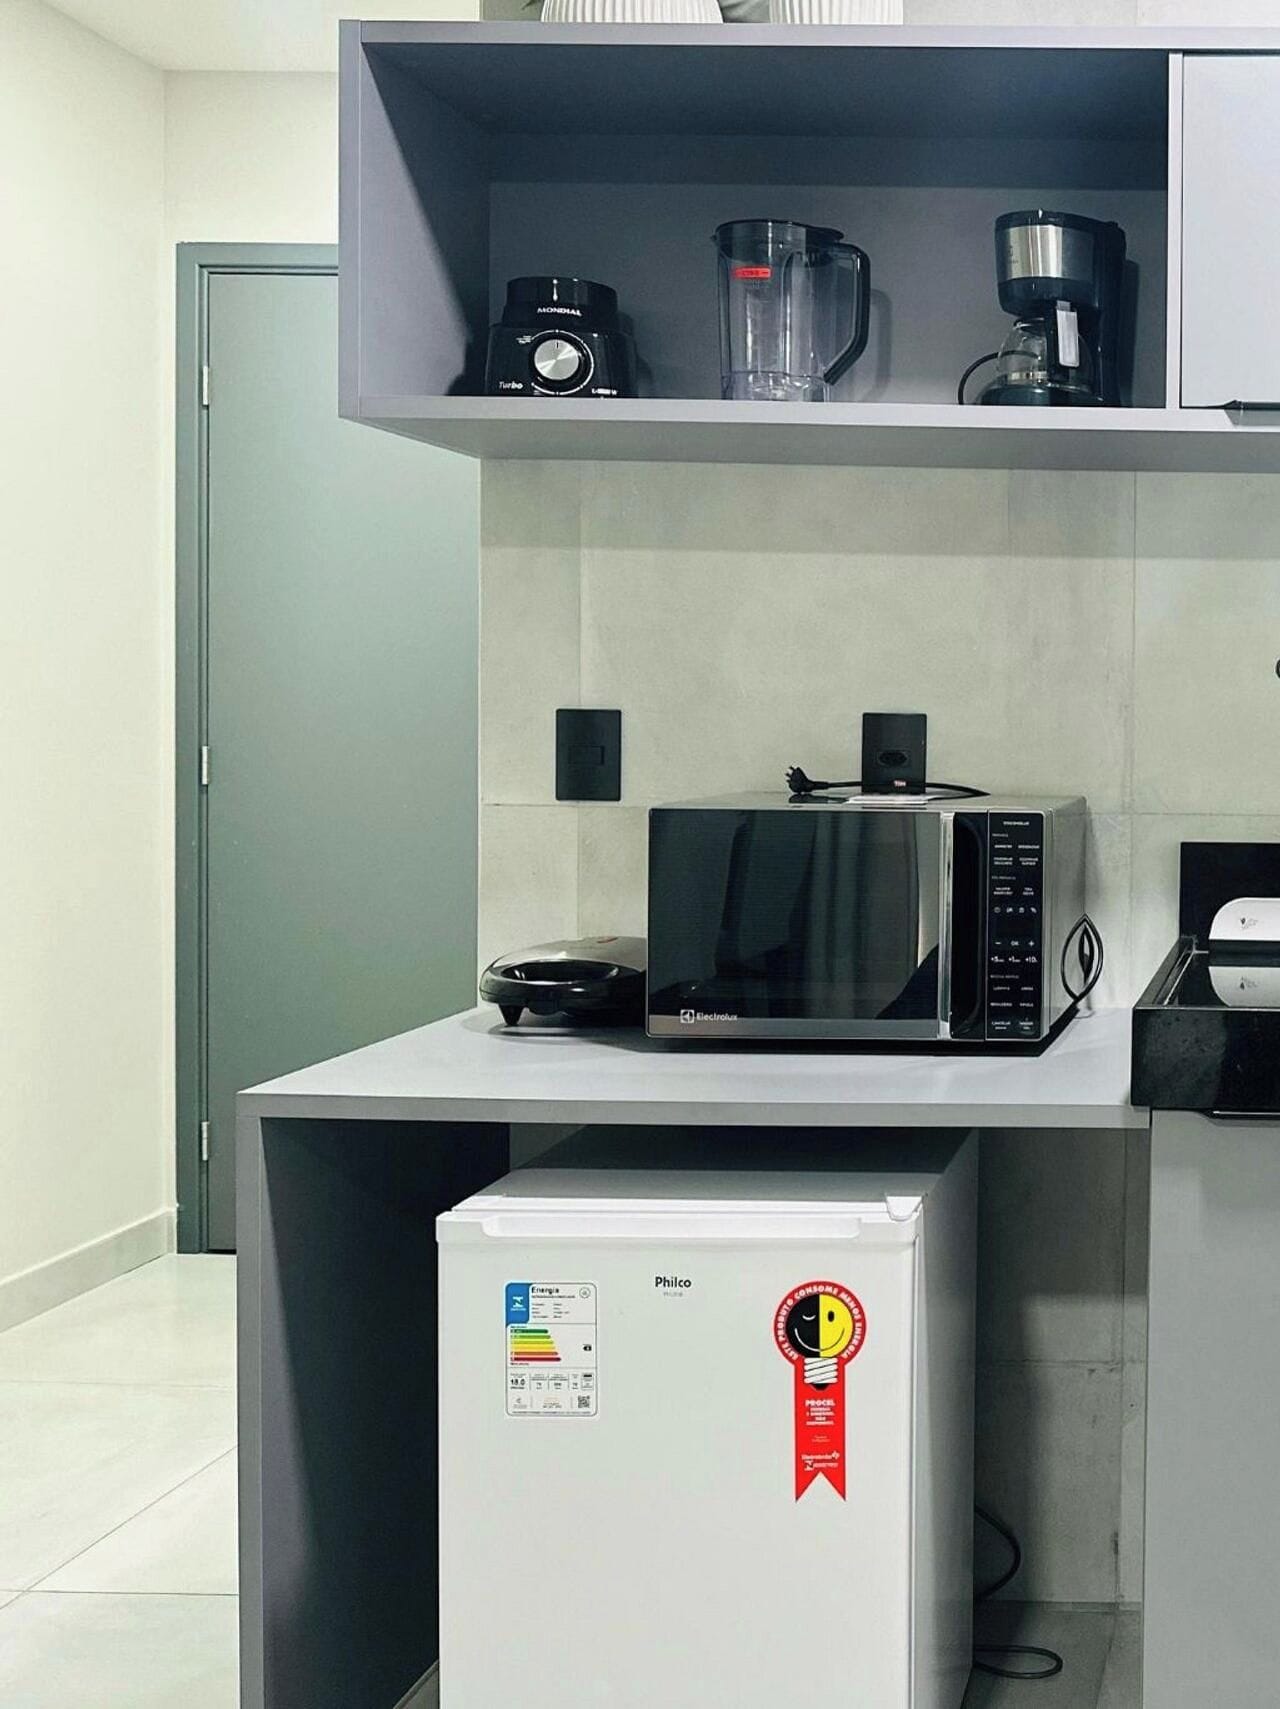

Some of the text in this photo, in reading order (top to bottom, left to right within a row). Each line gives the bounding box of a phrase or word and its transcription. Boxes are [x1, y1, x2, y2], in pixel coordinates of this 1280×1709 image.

[537, 307, 582, 317] MONDIAL
[499, 381, 523, 389] Turbo
[696, 1012, 738, 1021] Electrolux
[655, 1276, 692, 1288] Philco
[777, 1298, 794, 1341] PRODUTO
[794, 1285, 838, 1300] CONSOME
[839, 1291, 861, 1319] MENOS
